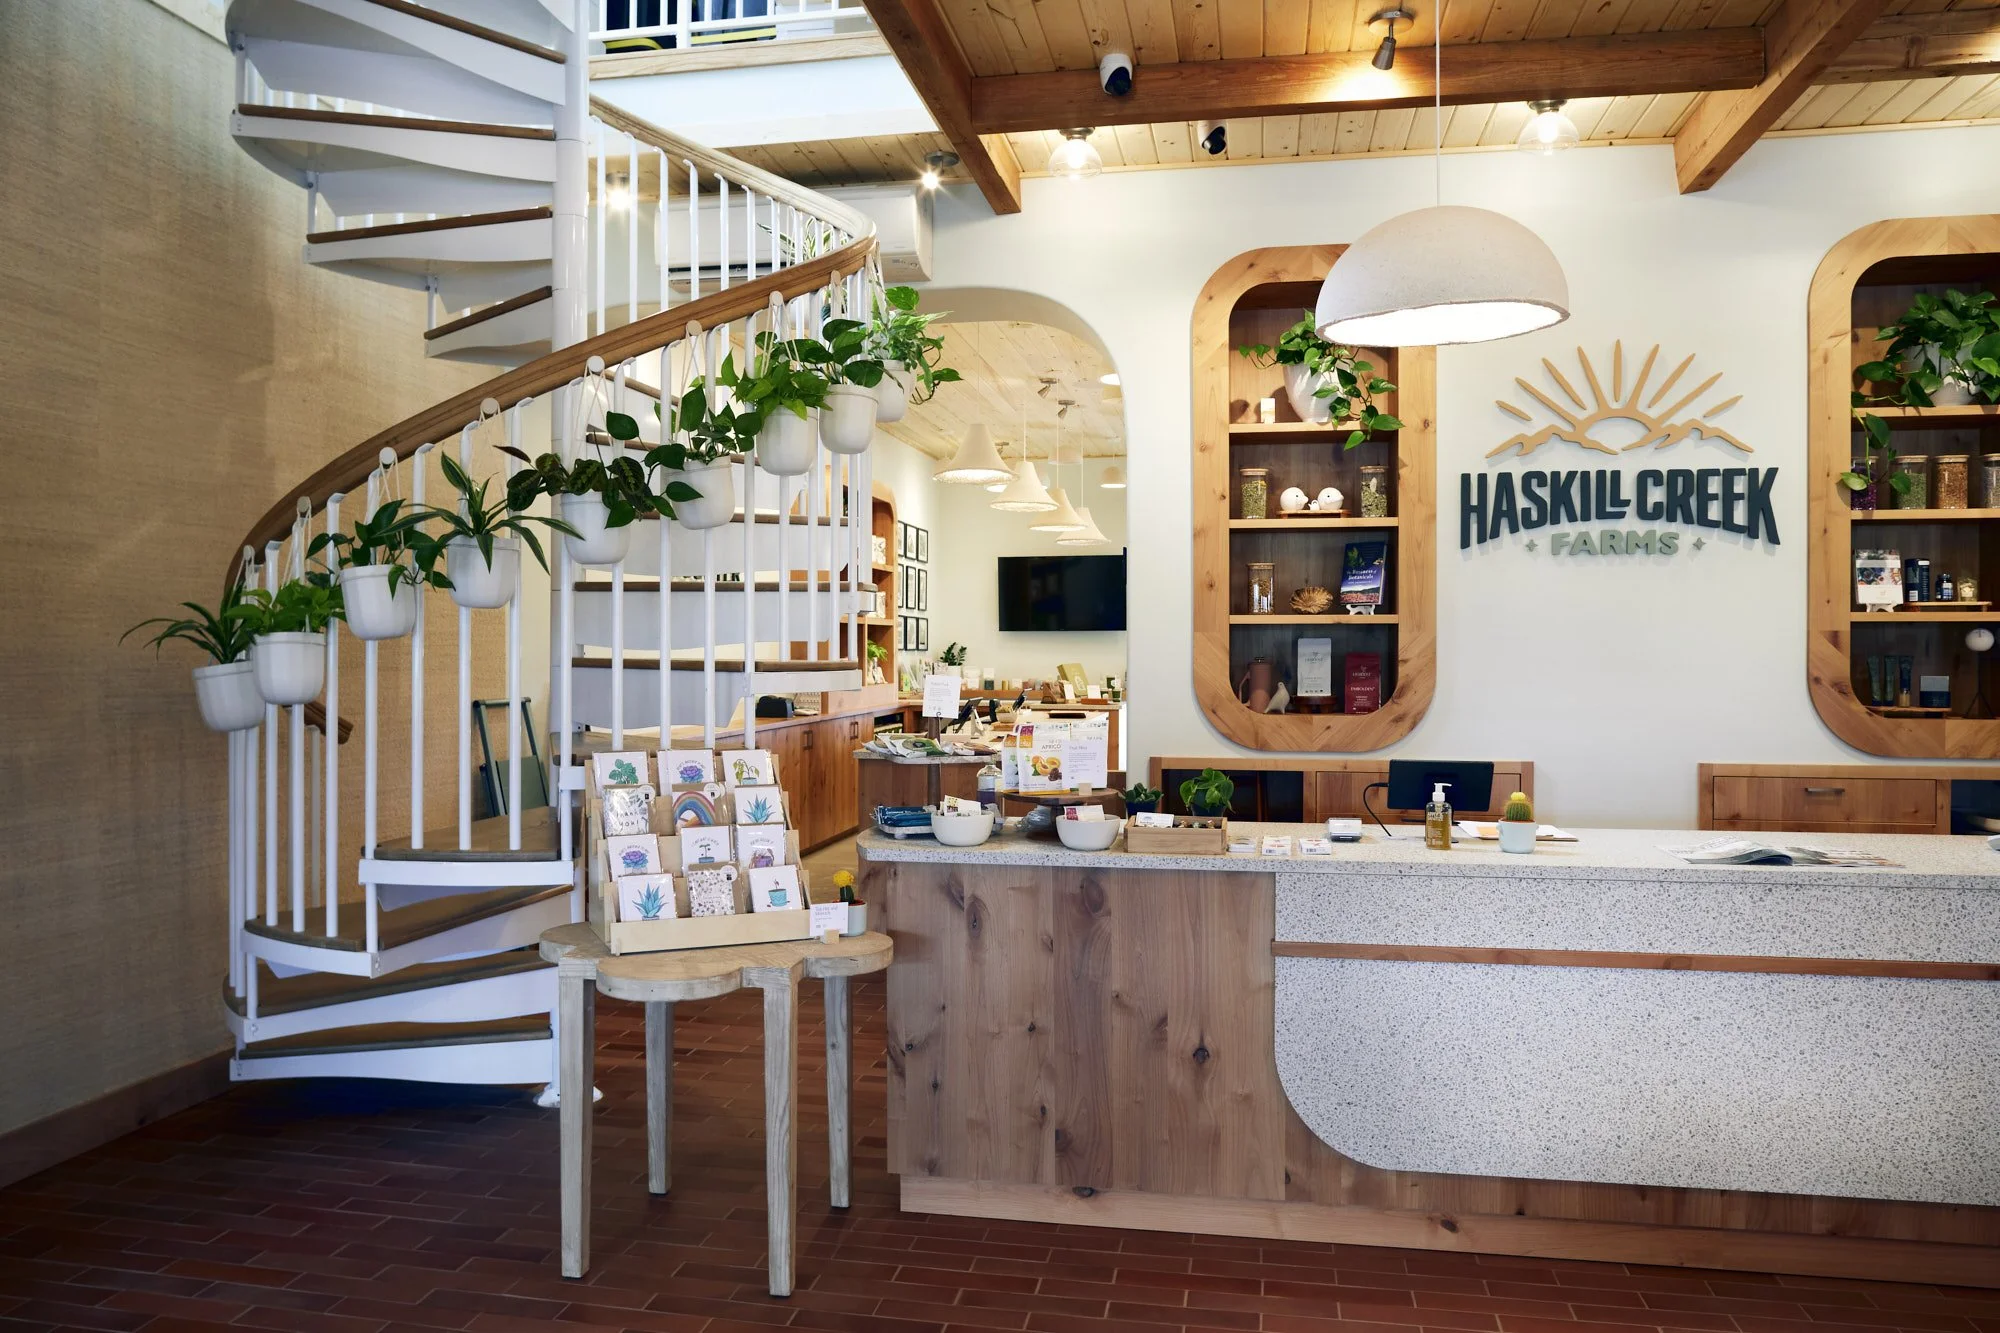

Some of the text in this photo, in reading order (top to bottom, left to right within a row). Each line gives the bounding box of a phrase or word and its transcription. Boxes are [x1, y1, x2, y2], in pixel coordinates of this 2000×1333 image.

[1460, 467, 1781, 549] HASKILL CREEK
[1551, 529, 1680, 555] FARMS
